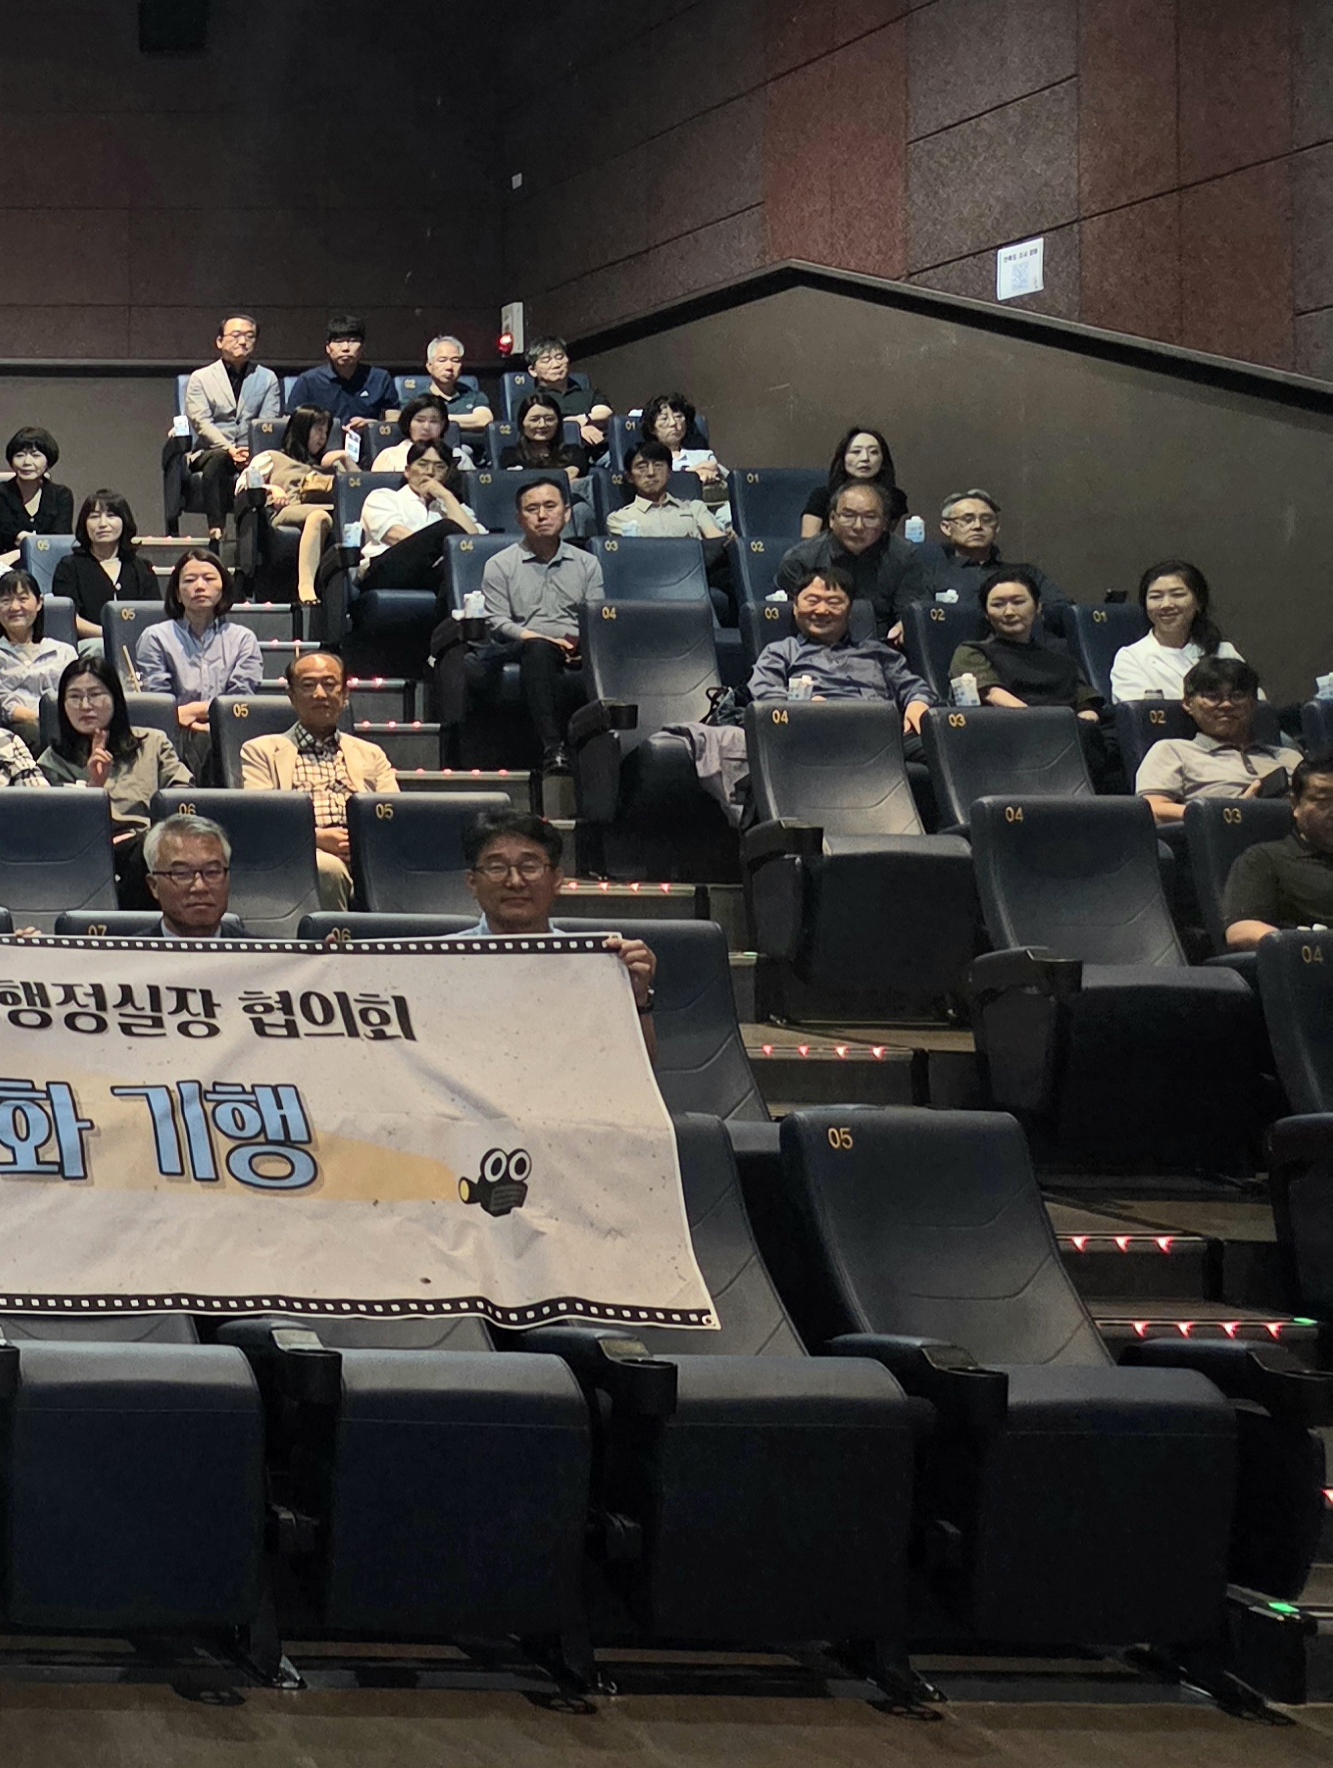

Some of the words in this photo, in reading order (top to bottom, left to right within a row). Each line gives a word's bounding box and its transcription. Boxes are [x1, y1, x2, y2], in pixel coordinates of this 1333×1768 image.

[515, 376, 525, 384] 01
[262, 424, 273, 434] 04
[625, 422, 635, 430] 01
[480, 473, 491, 483] 03
[747, 473, 759, 483] 01
[37, 539, 49, 550] 05
[460, 540, 473, 551] 04
[605, 540, 618, 551] 03
[750, 541, 764, 552] 02
[121, 608, 135, 620] 05
[602, 607, 617, 619] 04
[765, 607, 779, 619] 03
[931, 609, 945, 621] 02
[1093, 611, 1107, 622] 01
[234, 703, 249, 717] 05
[773, 709, 788, 723] 04
[949, 713, 965, 726] 03
[1150, 710, 1165, 724] 02
[376, 804, 393, 818] 05
[1006, 807, 1023, 822] 04
[1223, 808, 1241, 822] 03
[1301, 946, 1323, 963] 04
[239, 988, 418, 1042] 협의회
[109, 1078, 320, 1191] 기행
[828, 1127, 852, 1149] 05
